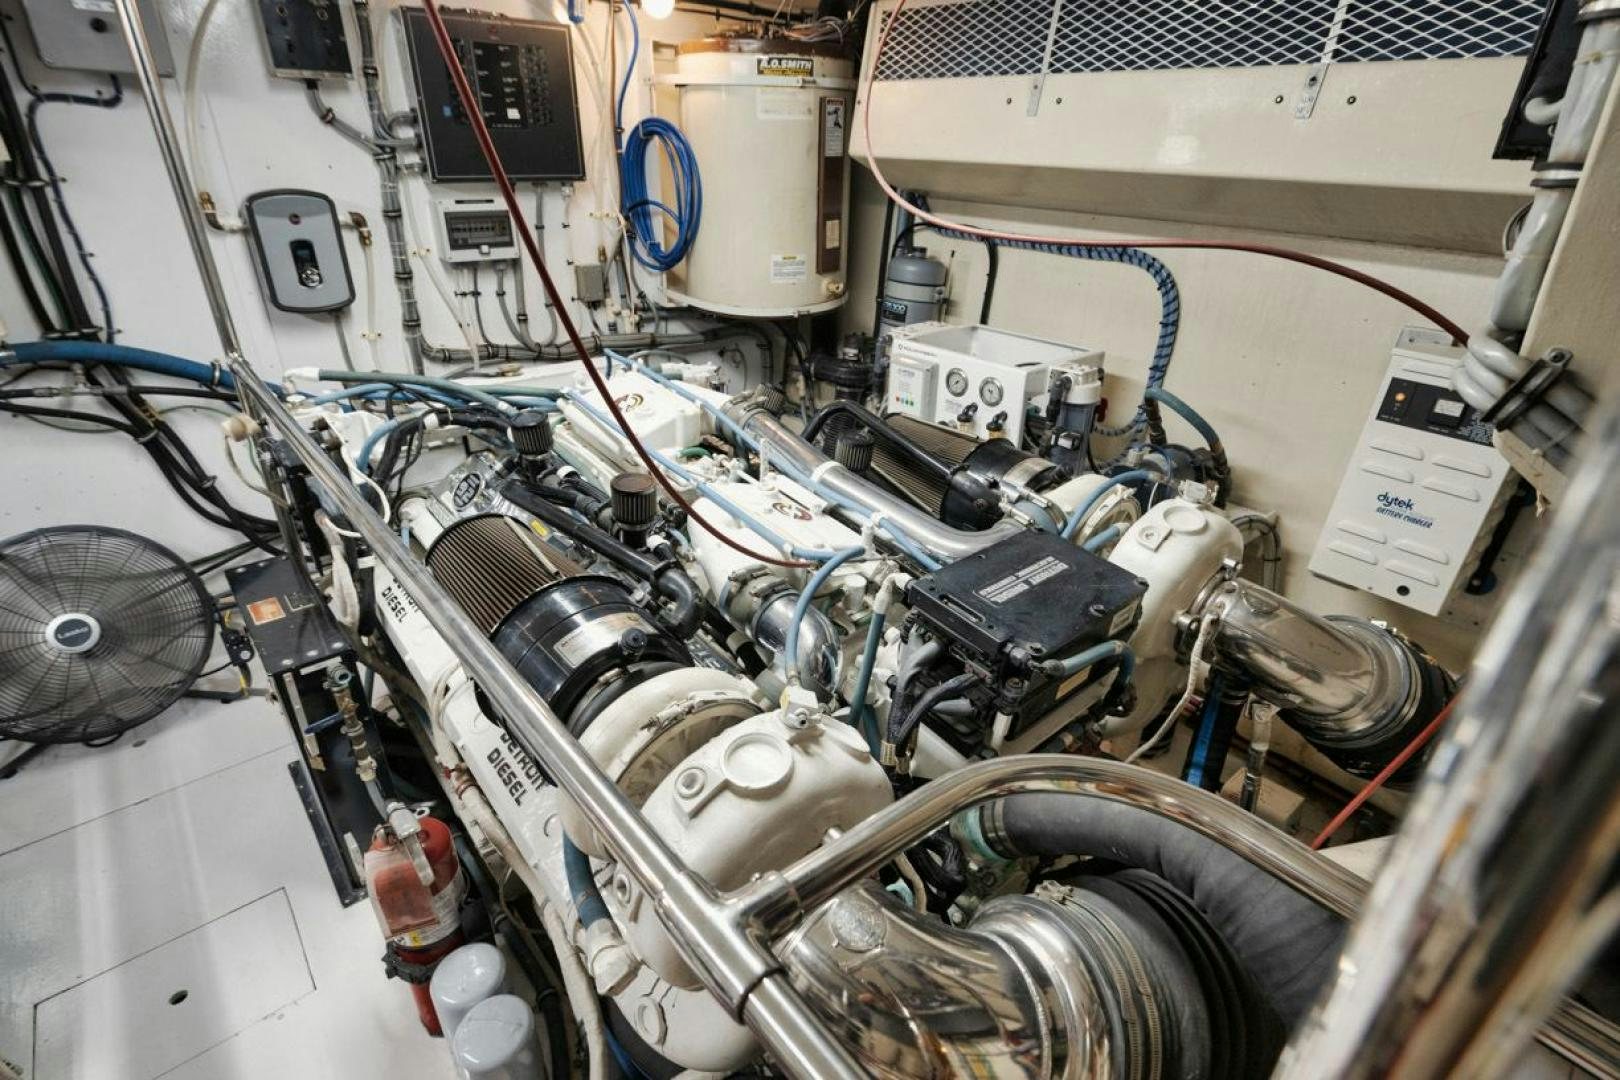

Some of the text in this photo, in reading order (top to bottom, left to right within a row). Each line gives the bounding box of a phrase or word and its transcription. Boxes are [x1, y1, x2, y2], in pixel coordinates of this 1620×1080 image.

[1376, 492, 1414, 511] dytek
[382, 586, 407, 623] DIESEL
[486, 747, 527, 807] DIESEL
